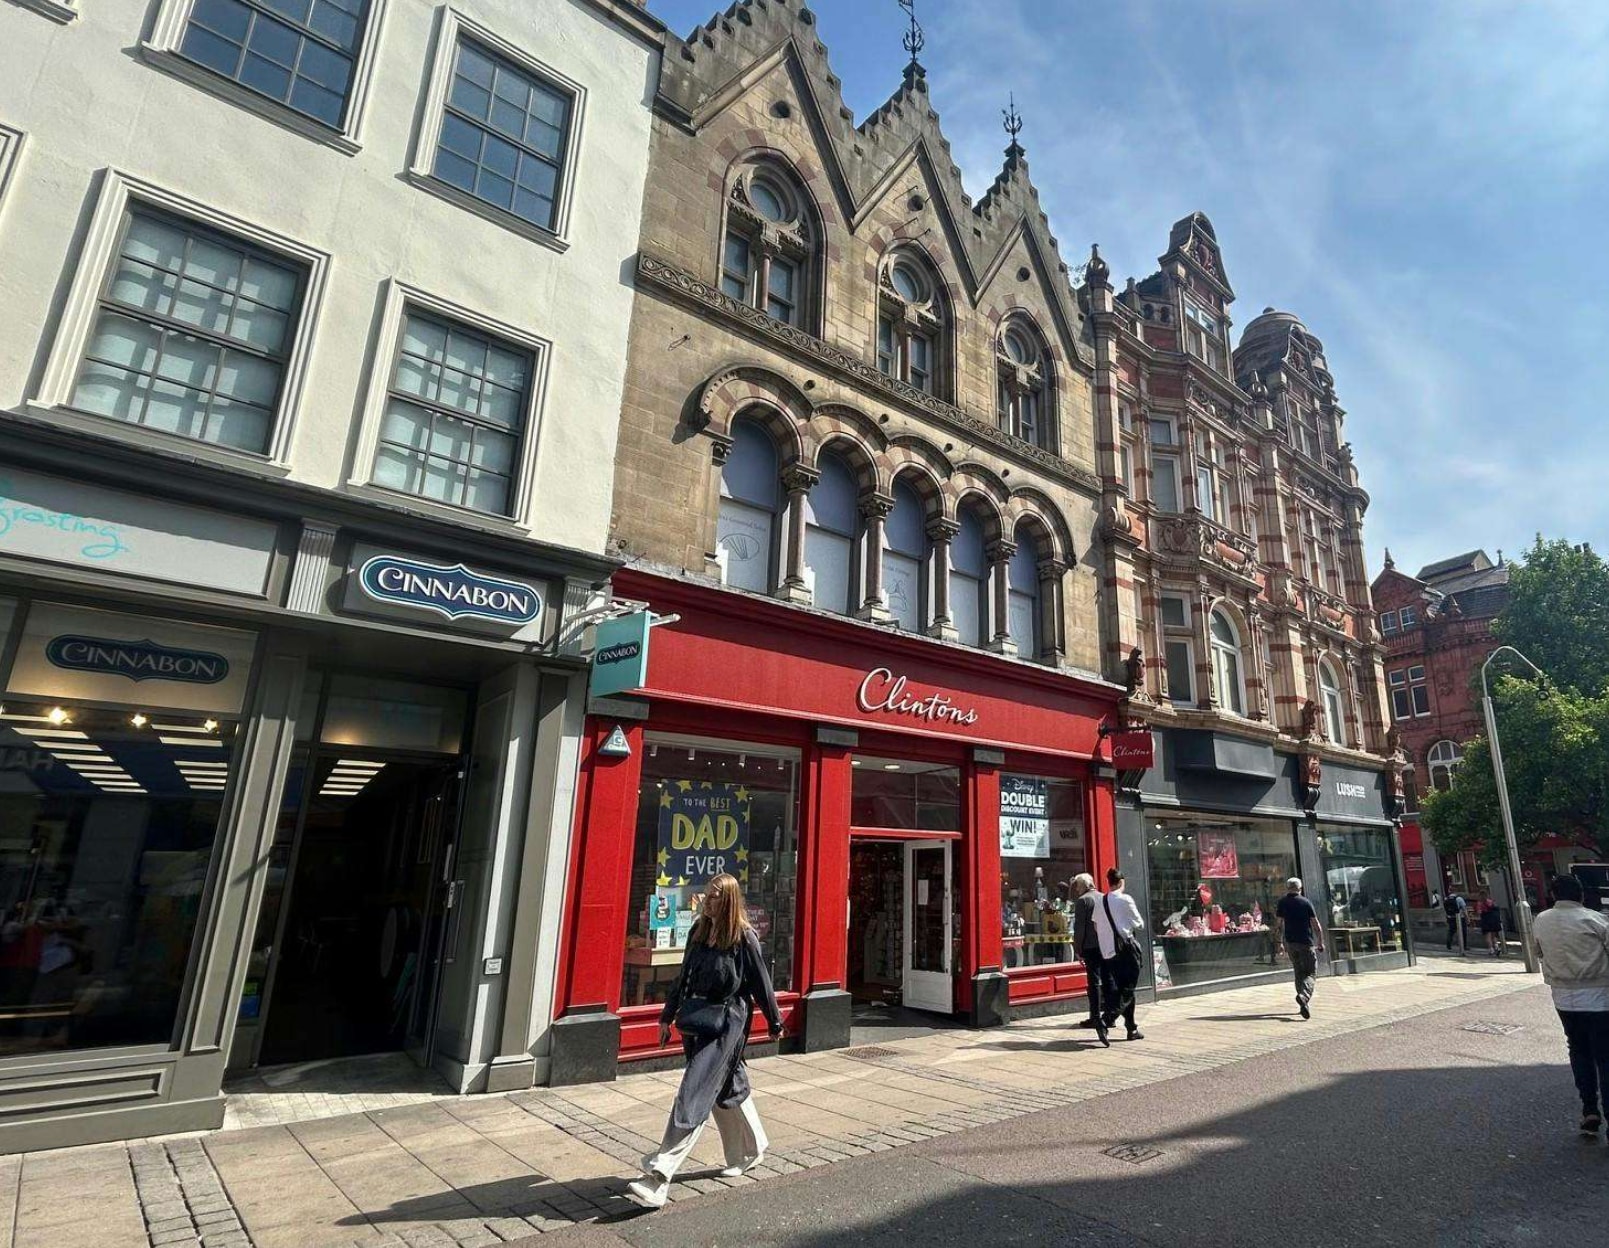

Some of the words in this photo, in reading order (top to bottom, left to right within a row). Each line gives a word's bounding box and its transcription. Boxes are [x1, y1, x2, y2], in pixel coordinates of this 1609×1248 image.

[377, 567, 528, 615] CINNABON
[62, 642, 217, 677] CINNABON
[599, 645, 637, 661] CINNABON
[860, 667, 978, 723] Clintons
[1114, 745, 1150, 757] Clintons
[1336, 782, 1355, 796] LUSH
[683, 798, 693, 807] TO
[711, 797, 730, 809] BEST
[1001, 791, 1045, 808] DOUBLE
[671, 813, 738, 850] DAD
[1010, 819, 1037, 834] WIN!
[685, 855, 726, 875] EVER
